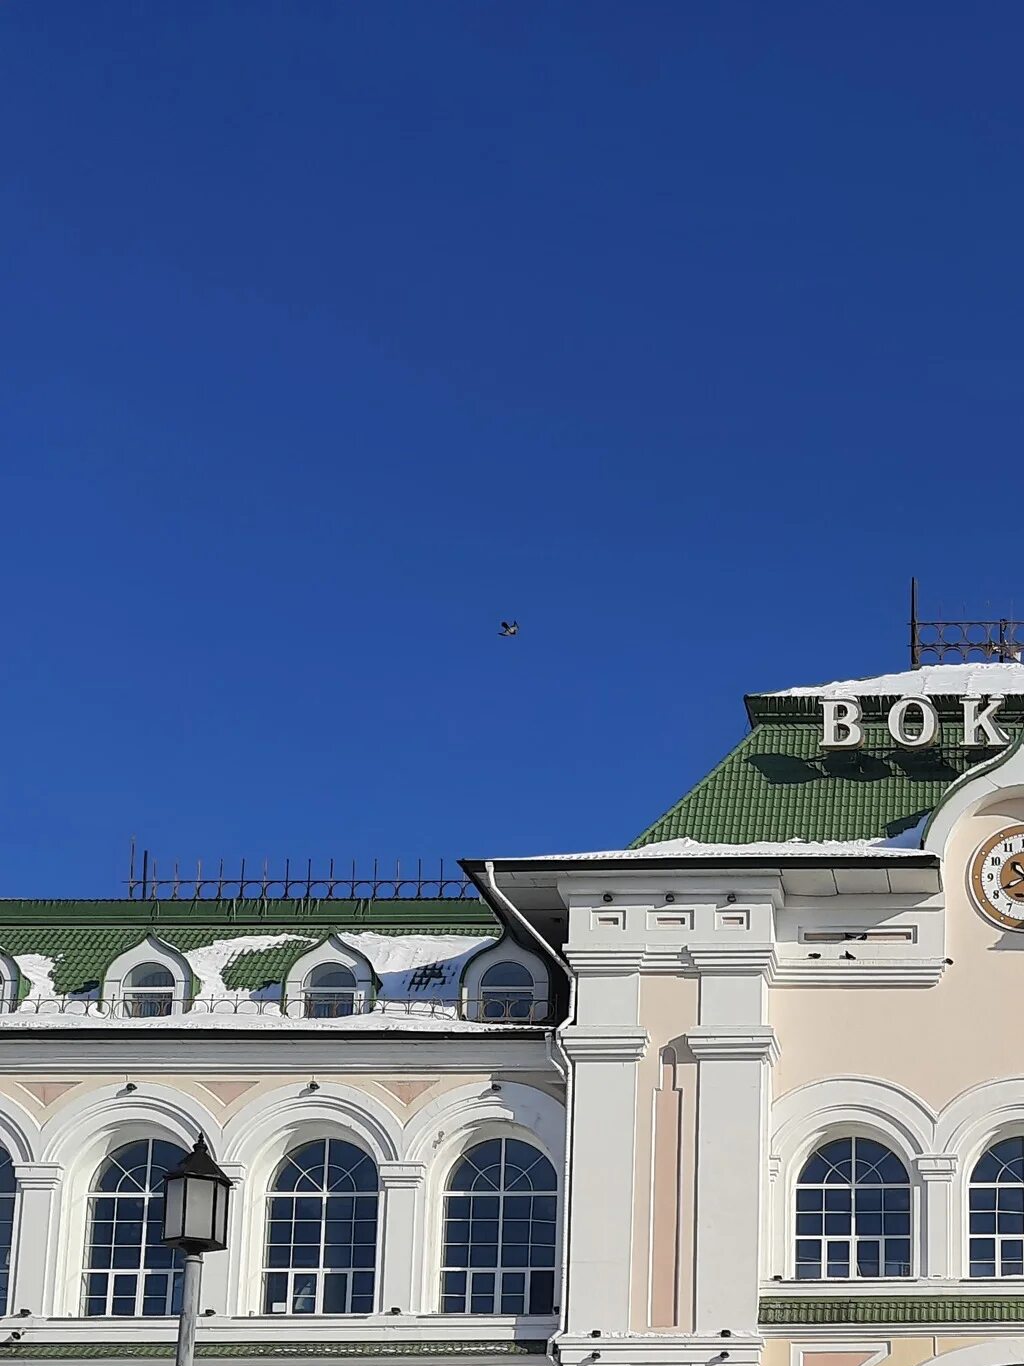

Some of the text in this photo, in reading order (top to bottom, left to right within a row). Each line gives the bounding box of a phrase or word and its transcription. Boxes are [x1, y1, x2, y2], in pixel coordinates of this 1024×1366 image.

[1004, 843, 1013, 852] 11
[991, 857, 1001, 866] 10
[987, 873, 994, 882] 9
[993, 890, 999, 899] 8
[1006, 903, 1013, 912] 7
